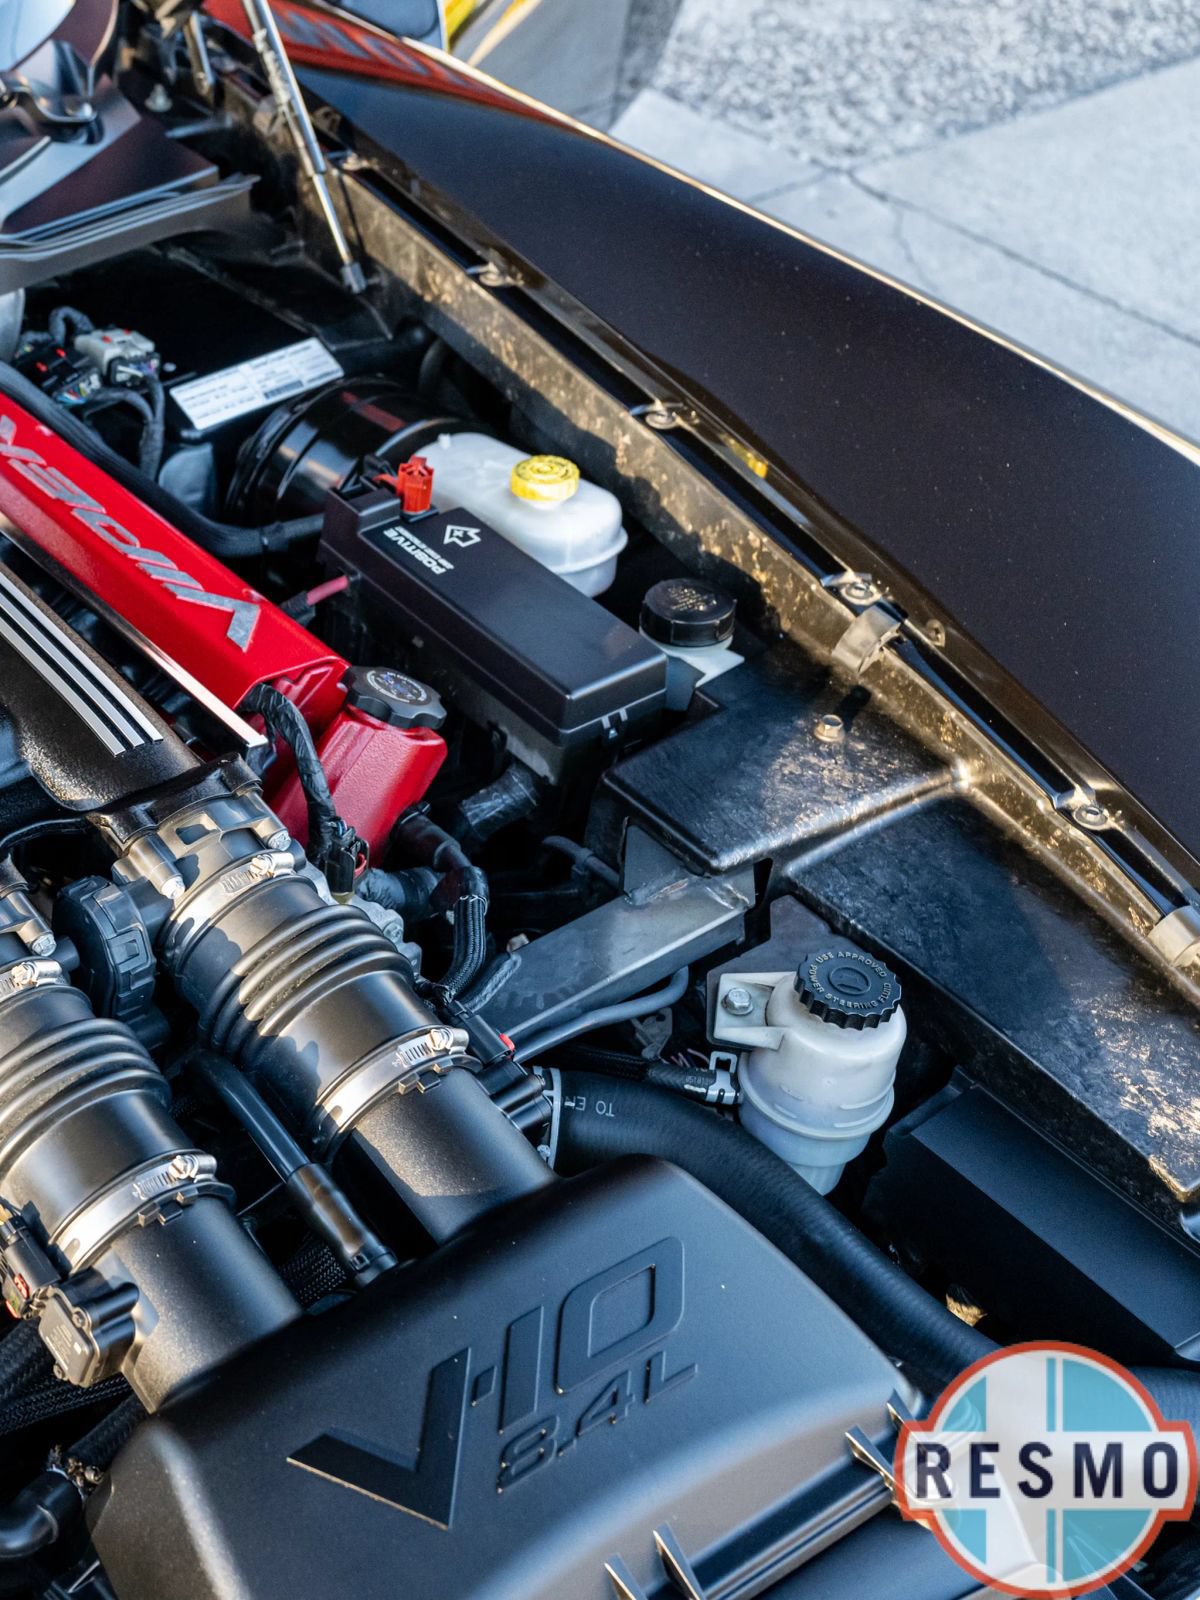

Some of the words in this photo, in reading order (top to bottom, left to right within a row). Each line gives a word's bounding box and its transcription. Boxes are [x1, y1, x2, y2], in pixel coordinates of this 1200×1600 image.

[383, 528, 447, 575] POSITIVE
[815, 951, 834, 963] USE
[837, 951, 887, 977] APPROVED
[808, 964, 825, 993] POWER
[825, 993, 879, 1009] STEERING
[595, 1100, 615, 1117] TO
[497, 1350, 698, 1493] 8.4L
